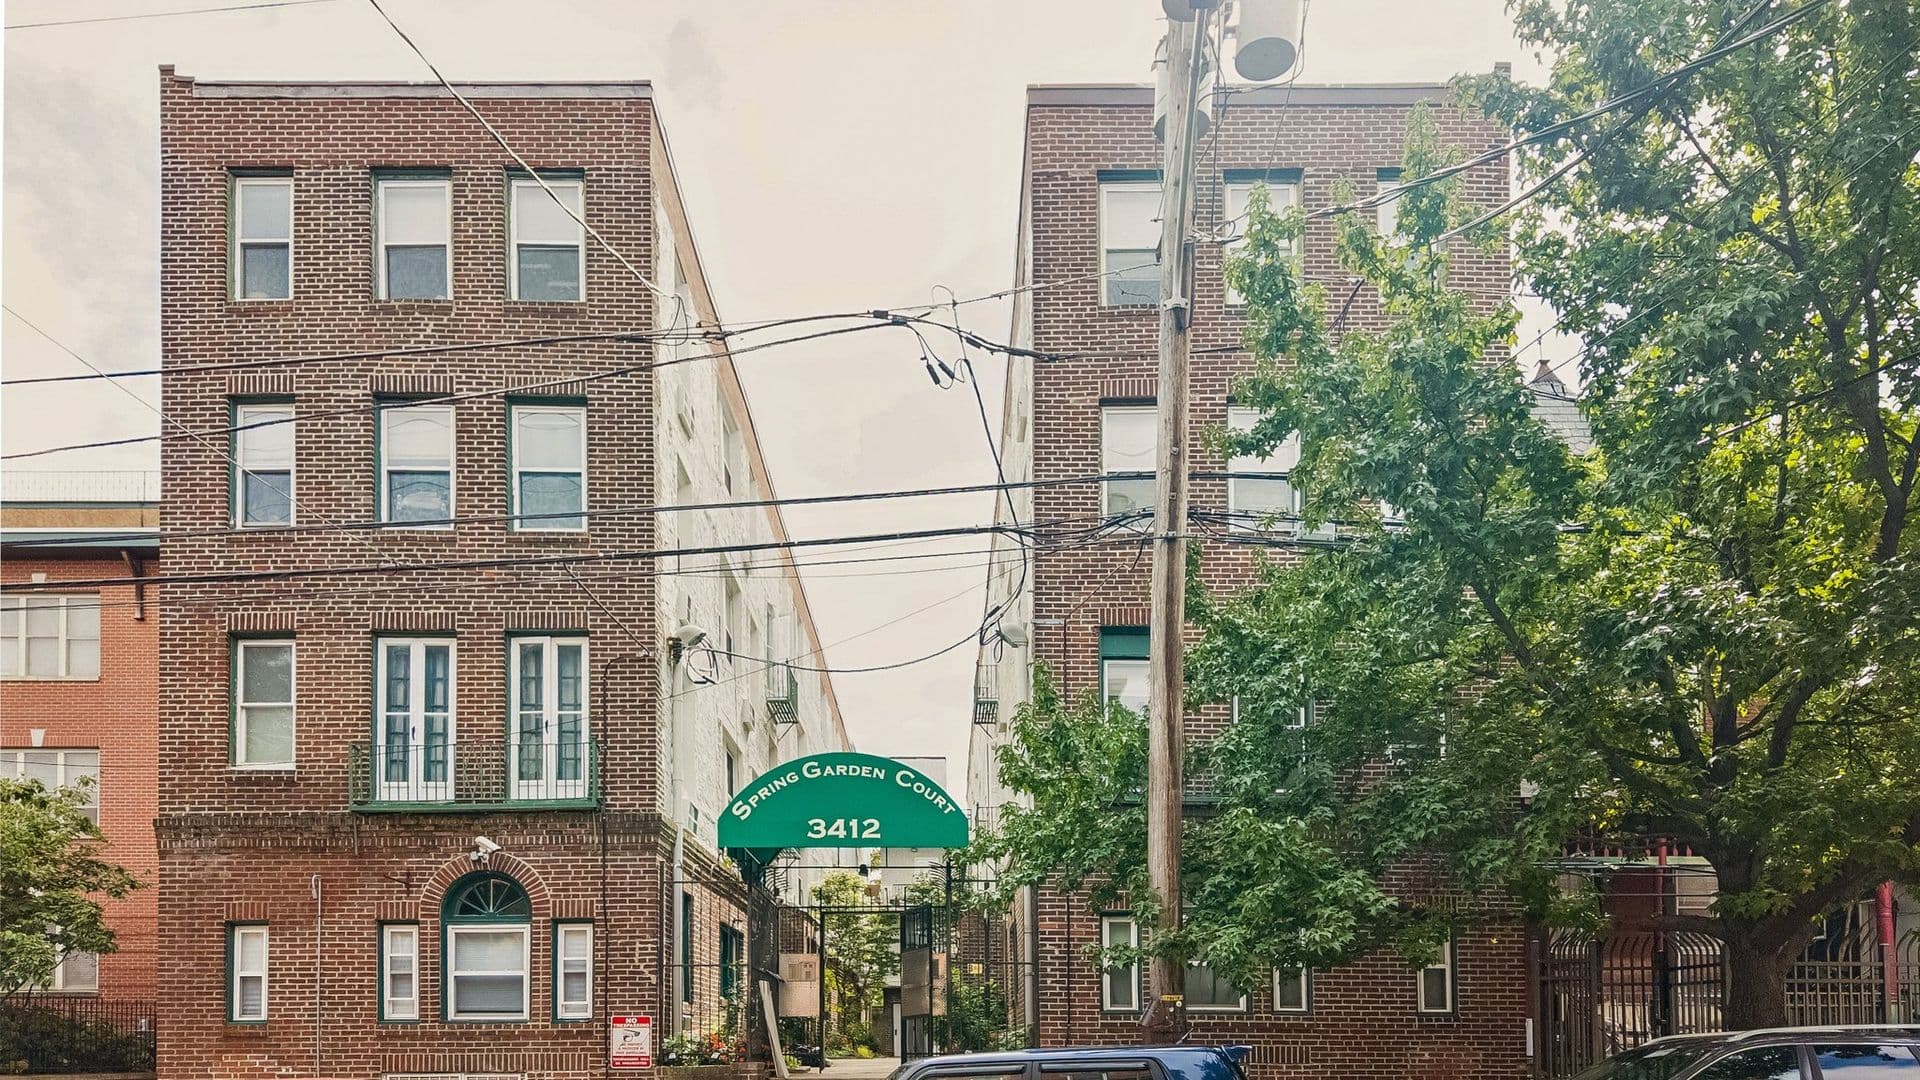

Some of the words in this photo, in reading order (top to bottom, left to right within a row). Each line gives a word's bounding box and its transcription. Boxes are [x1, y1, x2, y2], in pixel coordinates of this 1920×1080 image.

[731, 772, 799, 821] SPRING
[802, 761, 885, 780] GARDEN
[895, 770, 956, 814] COURT
[807, 818, 881, 839] 3412
